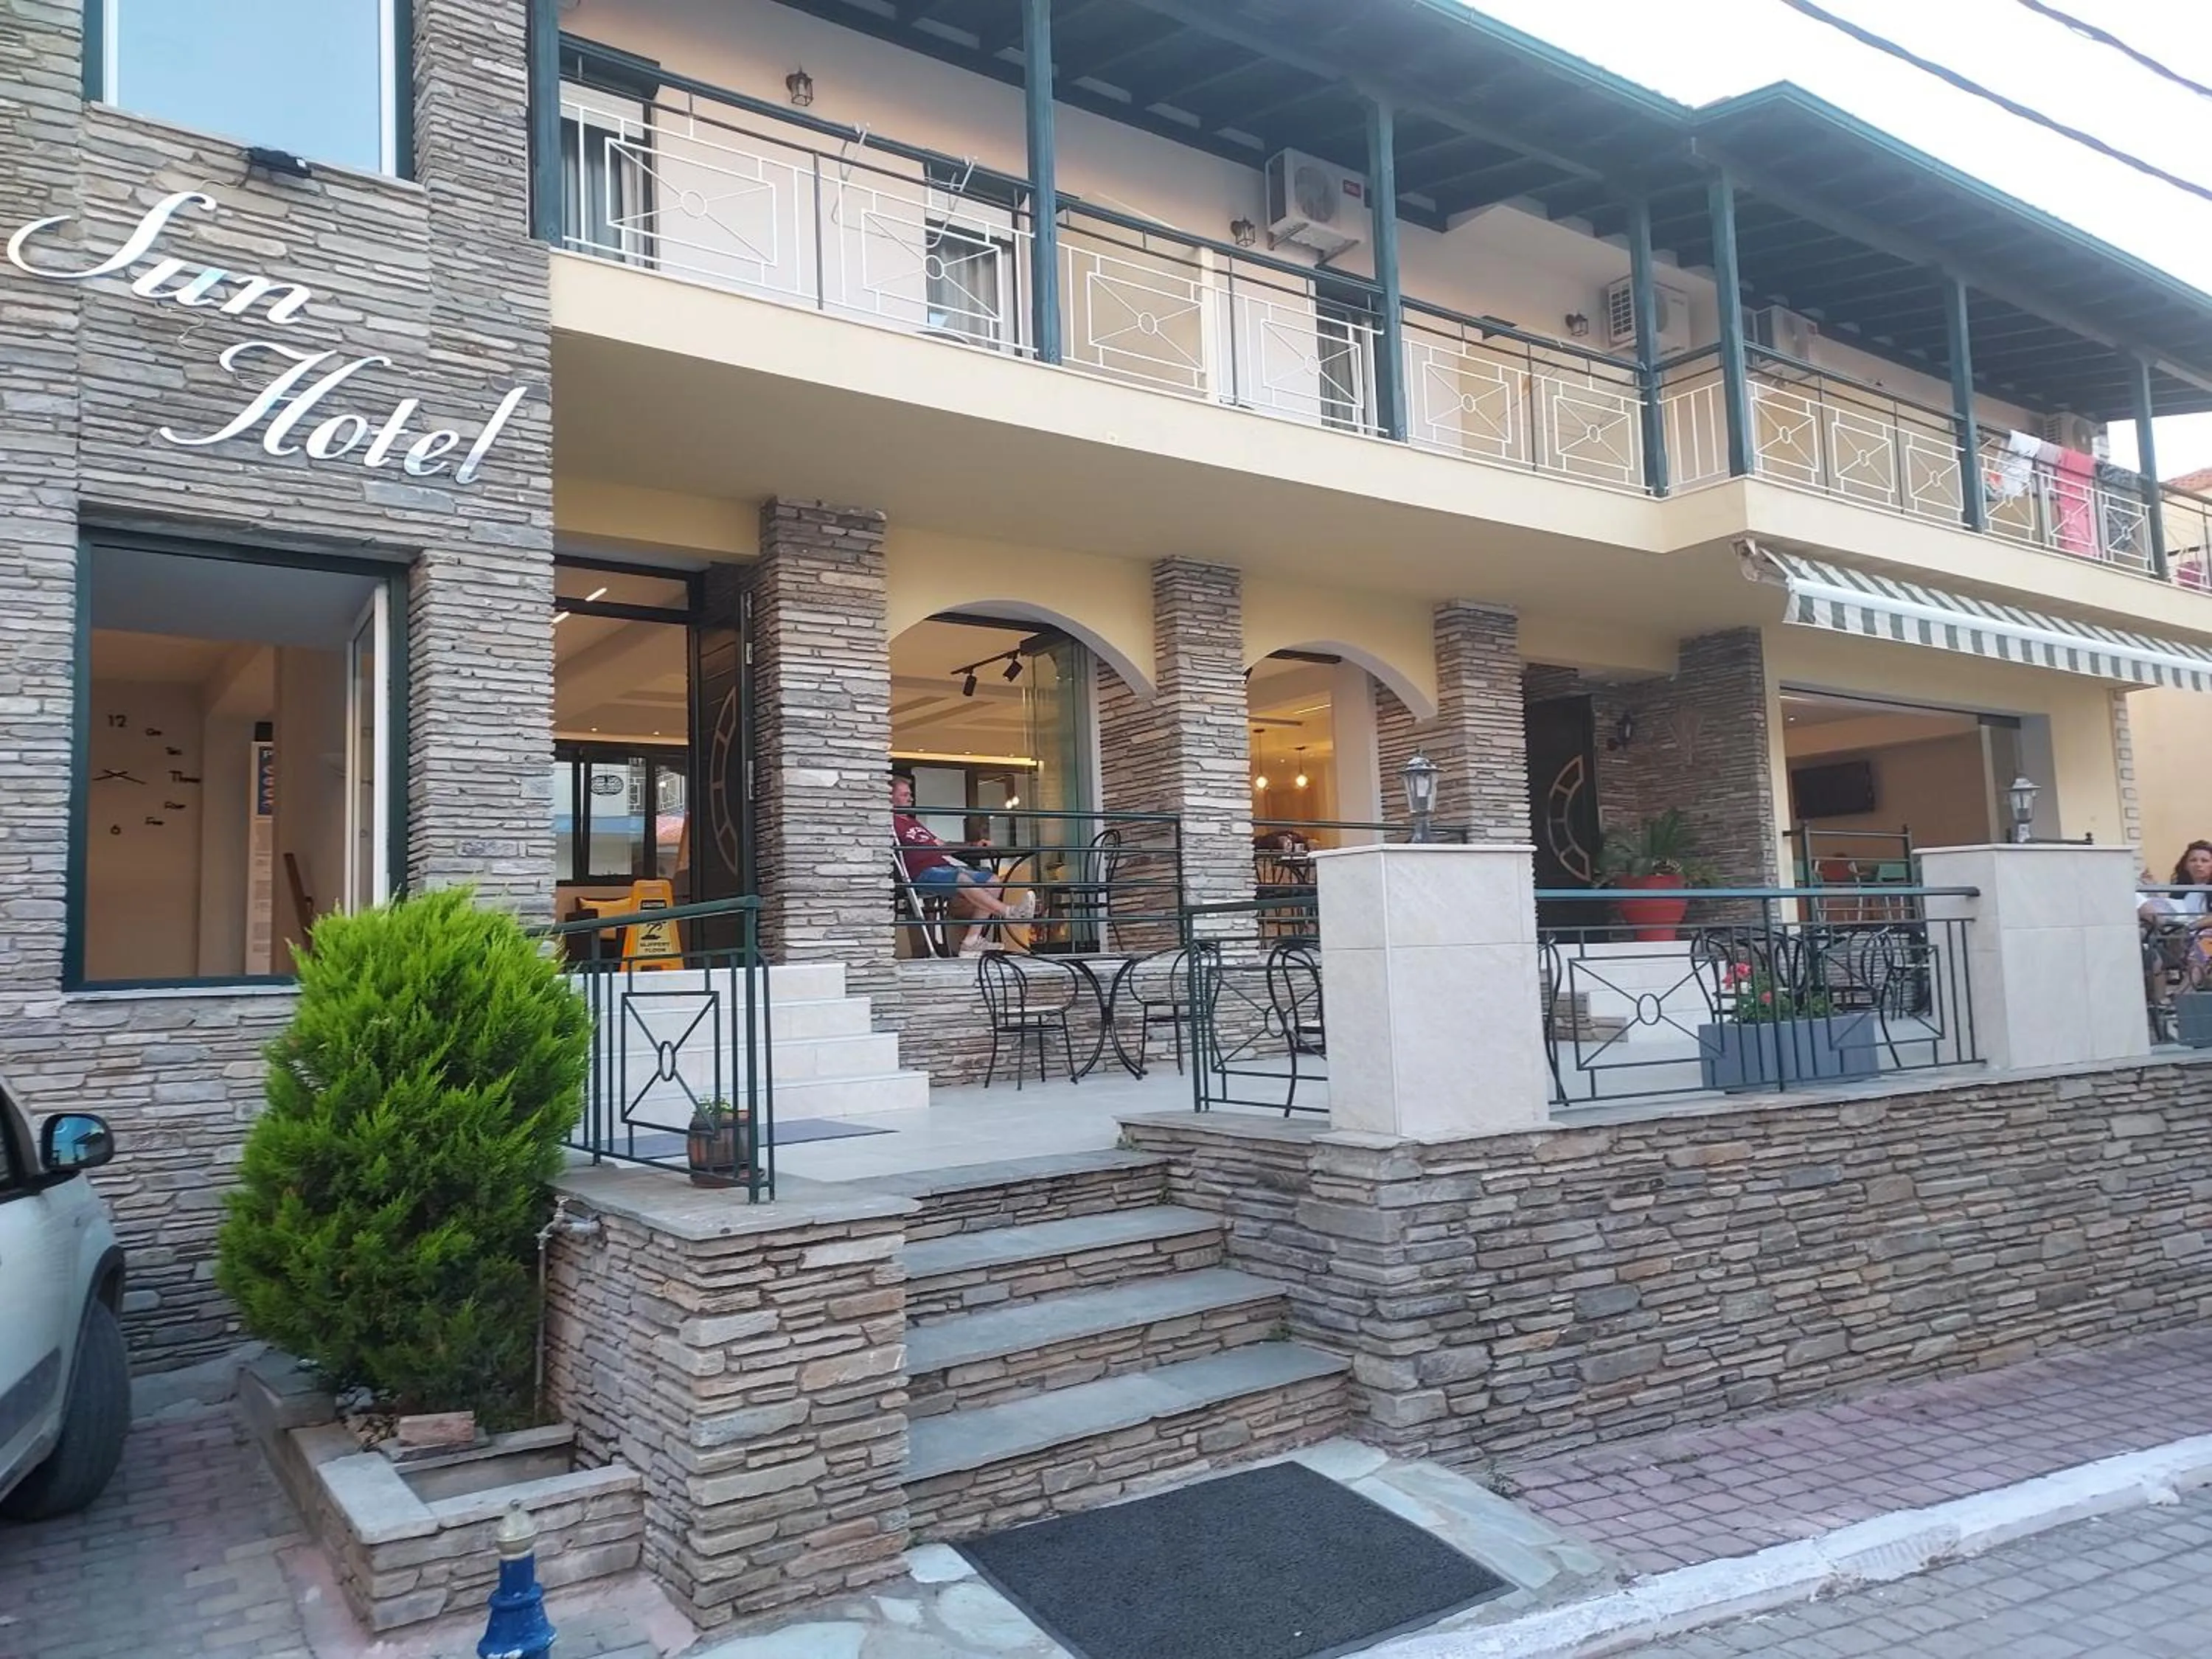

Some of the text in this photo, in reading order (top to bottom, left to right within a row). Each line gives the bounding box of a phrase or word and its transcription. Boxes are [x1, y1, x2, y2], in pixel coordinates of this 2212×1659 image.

[7, 192, 311, 324] Sun
[159, 341, 527, 485] Hotel
[108, 714, 127, 727] 12
[110, 824, 121, 835] 6
